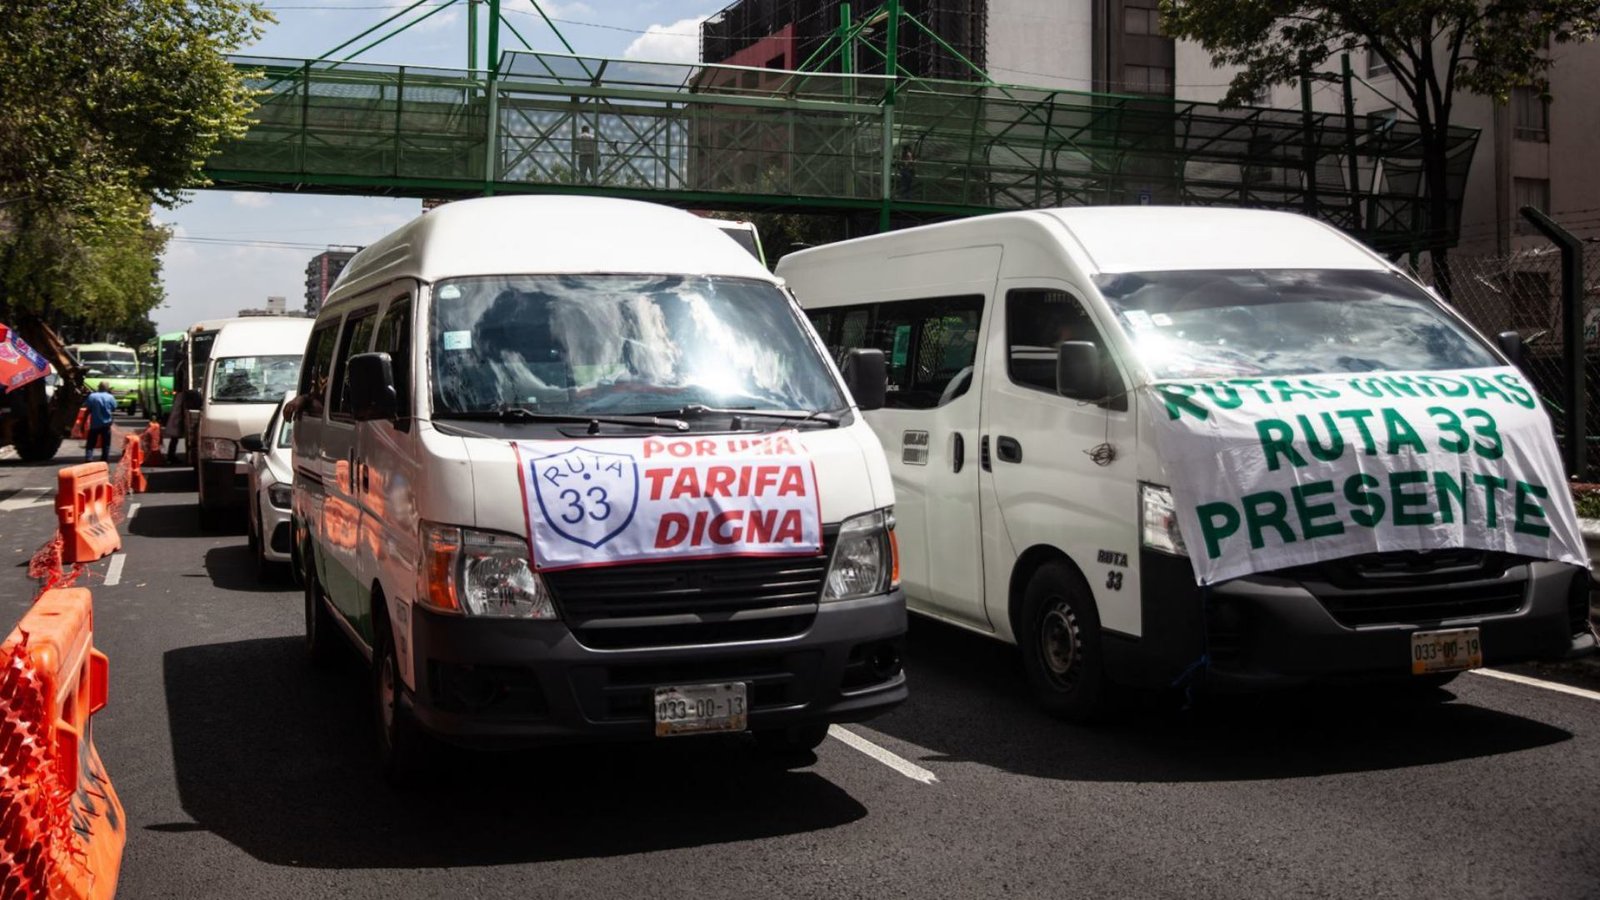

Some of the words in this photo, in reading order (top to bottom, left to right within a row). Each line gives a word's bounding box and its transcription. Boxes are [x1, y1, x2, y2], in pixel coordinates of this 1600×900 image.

[1156, 378, 1341, 421] RUTAS
[643, 438, 717, 459] POR
[727, 436, 796, 455] UNA
[1255, 409, 1427, 472] RUTA
[1426, 406, 1504, 460] 33
[543, 456, 622, 487] RUTA
[645, 465, 806, 501] TARIFA
[560, 486, 612, 524] 33
[1196, 471, 1550, 559] PRESENTE
[654, 509, 803, 549] DIGNA
[1097, 549, 1128, 568] RUTA
[1106, 570, 1123, 591] 33
[1415, 639, 1479, 661] 033-00-19
[659, 697, 743, 720] 033-00-13
